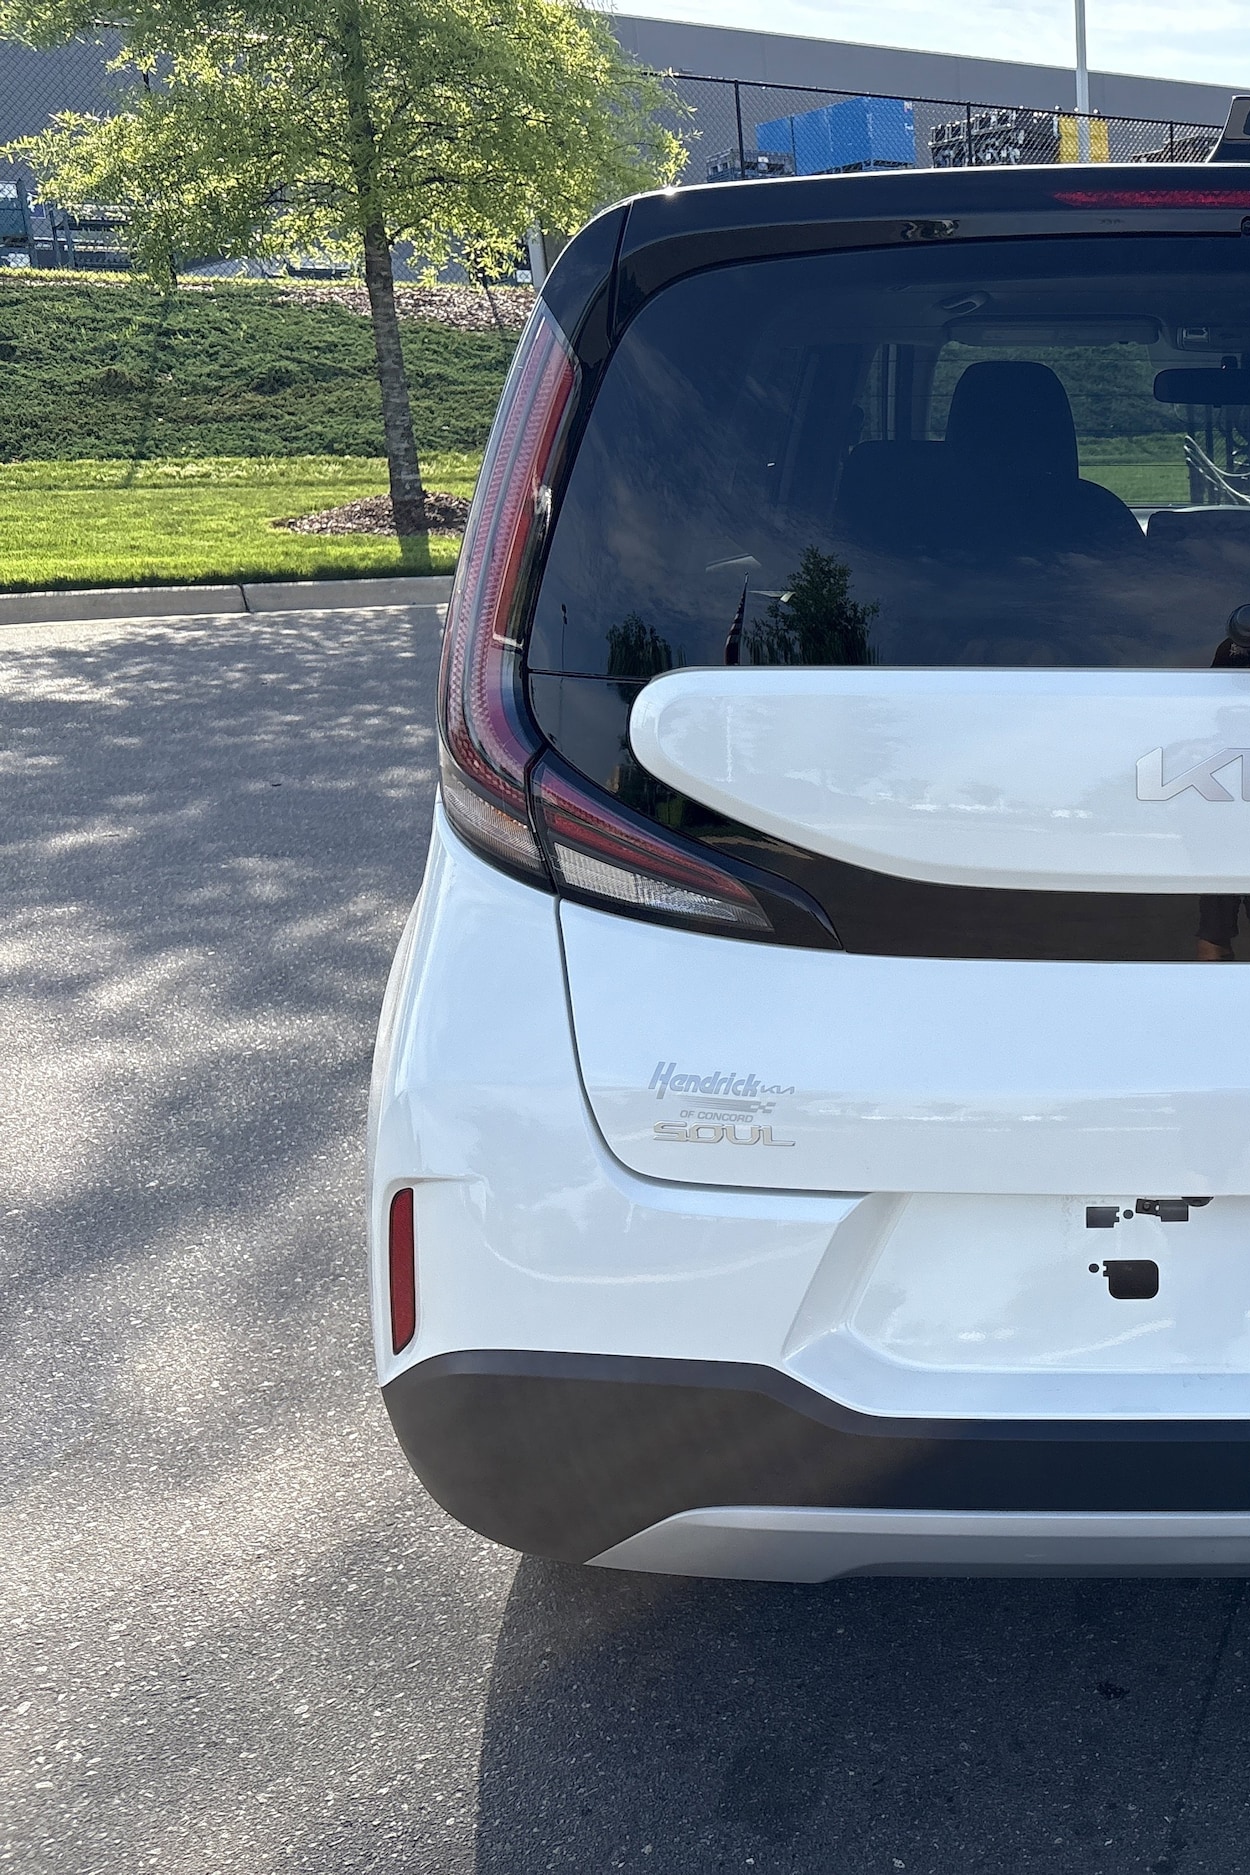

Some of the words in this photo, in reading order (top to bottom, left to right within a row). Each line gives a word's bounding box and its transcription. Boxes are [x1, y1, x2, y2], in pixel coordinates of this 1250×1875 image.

[648, 1061, 761, 1099] Hendrick
[680, 1109, 694, 1119] OF
[697, 1111, 754, 1123] CONCORD
[653, 1120, 796, 1147] SOUL
